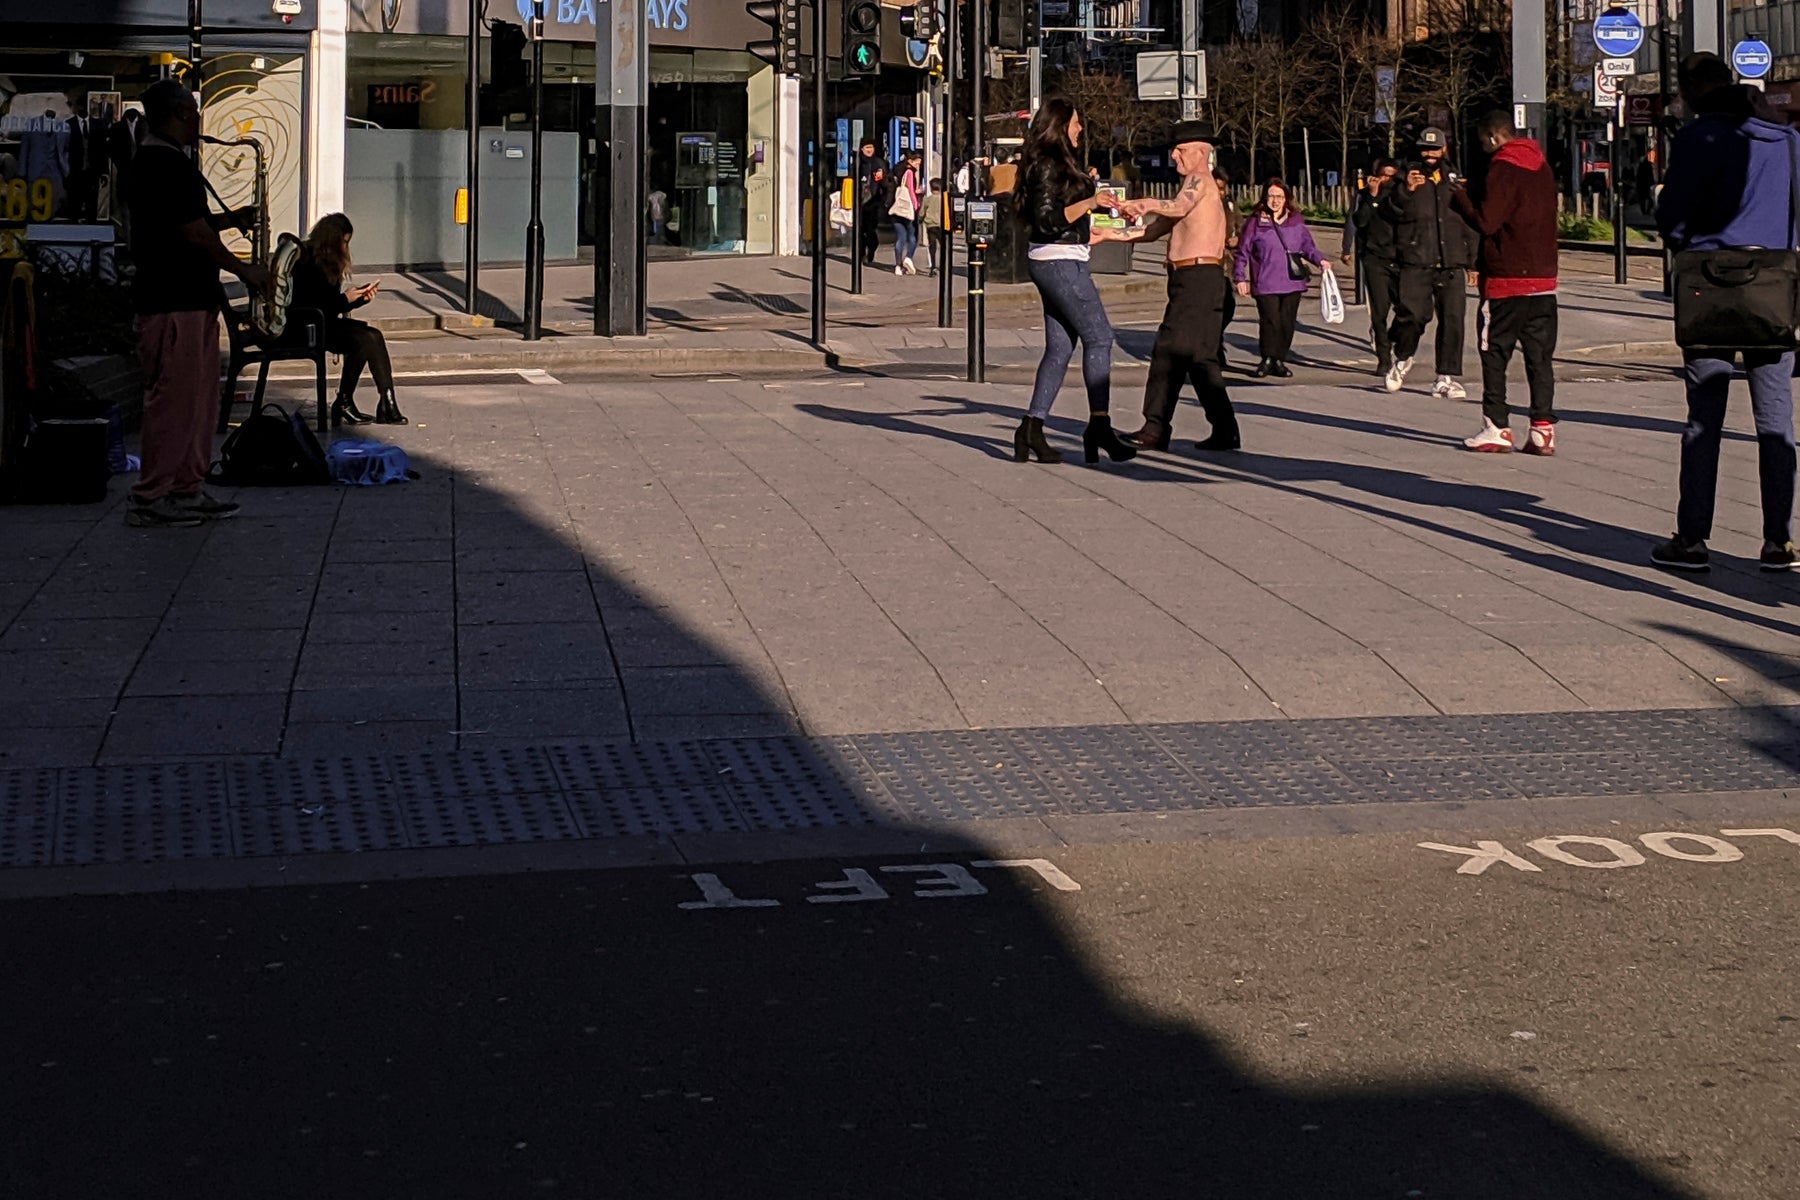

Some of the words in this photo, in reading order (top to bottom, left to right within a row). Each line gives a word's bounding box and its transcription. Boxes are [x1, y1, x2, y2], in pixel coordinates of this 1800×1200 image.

[1607, 62, 1631, 72] Only
[1597, 95, 1615, 103] ZON
[677, 857, 1081, 910] LEFT
